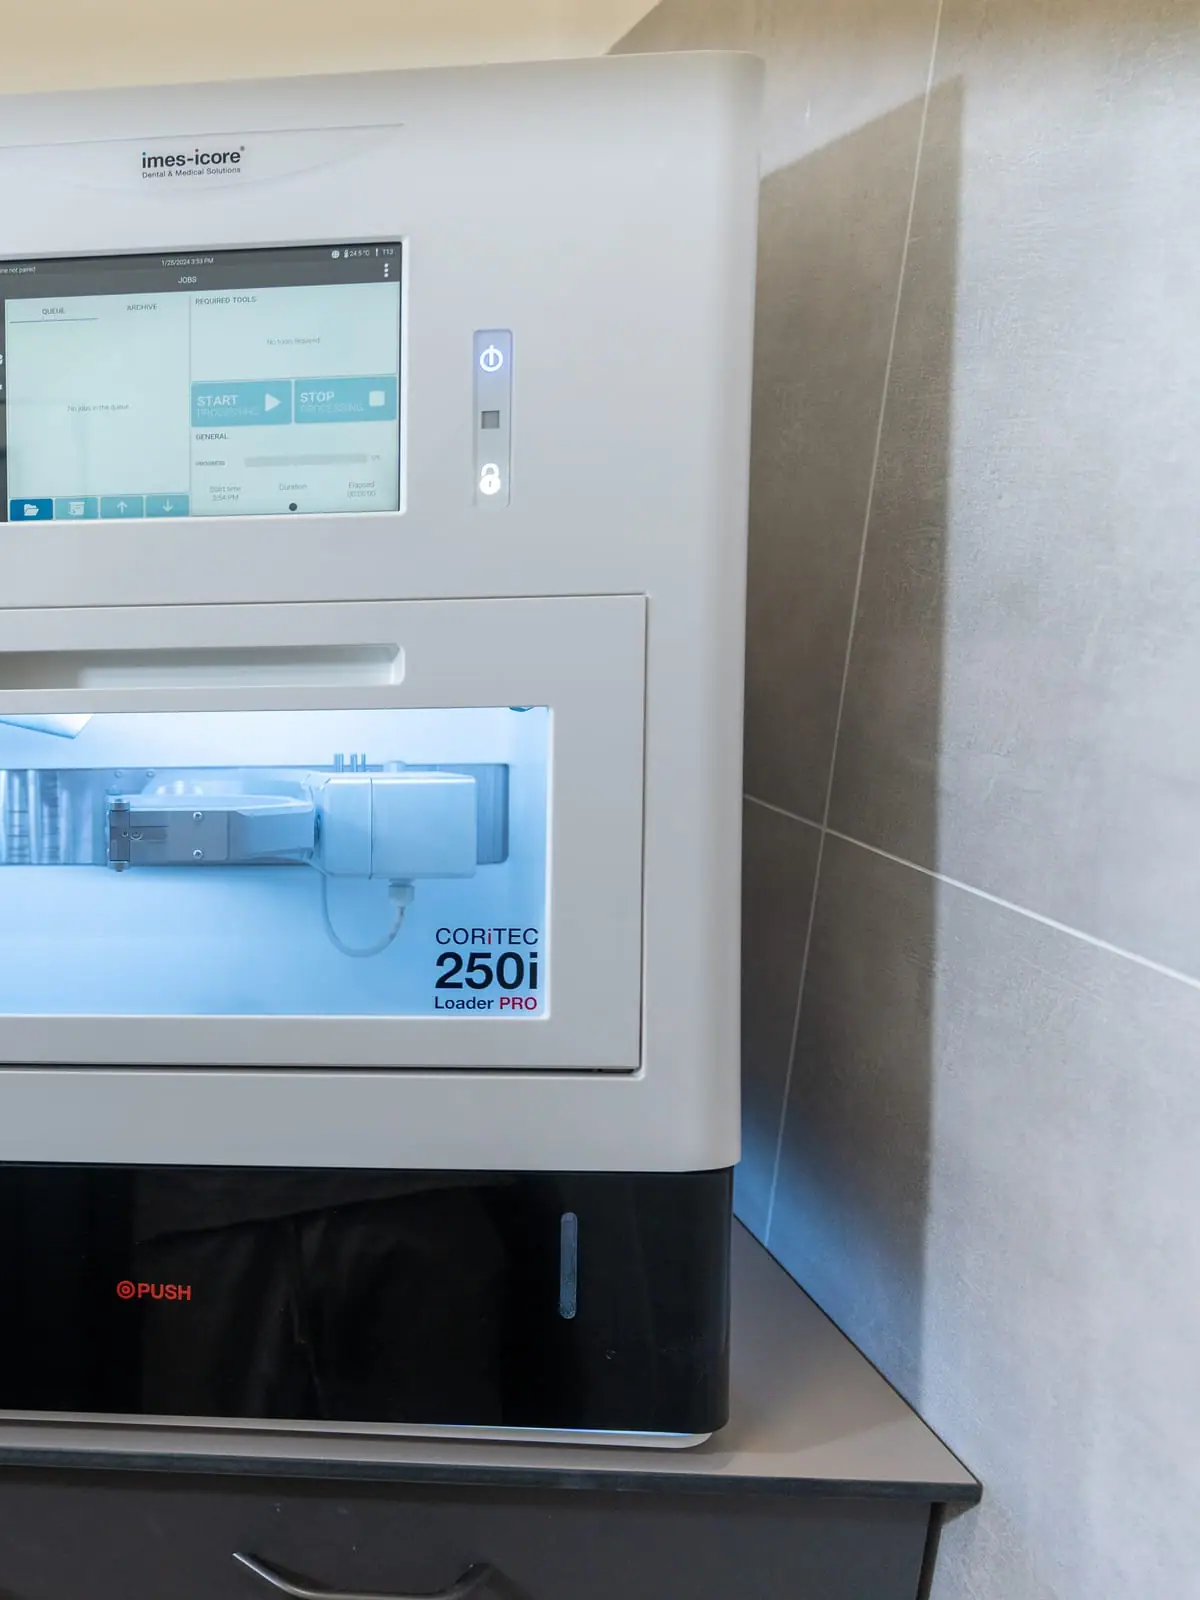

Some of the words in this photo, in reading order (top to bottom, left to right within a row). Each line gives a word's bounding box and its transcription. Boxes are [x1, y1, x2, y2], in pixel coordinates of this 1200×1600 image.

[142, 169, 166, 179] Dental
[167, 170, 173, 178] &
[175, 167, 204, 177] Medical
[206, 166, 241, 175] Solutions
[204, 256, 214, 264] PM
[177, 275, 197, 284] JOBS
[195, 297, 231, 305] REQUIRED
[233, 295, 257, 304] TOOLS
[41, 307, 66, 315] QUEUE
[126, 303, 158, 312] ARCHIVE
[196, 394, 239, 407] START
[299, 391, 335, 404] STOP
[195, 432, 228, 441] GENERAL
[435, 927, 539, 945] CORiTEC
[434, 951, 538, 990] 250i
[434, 995, 494, 1010] Loader
[499, 996, 538, 1011] PRO
[137, 1282, 192, 1301] PUSH
